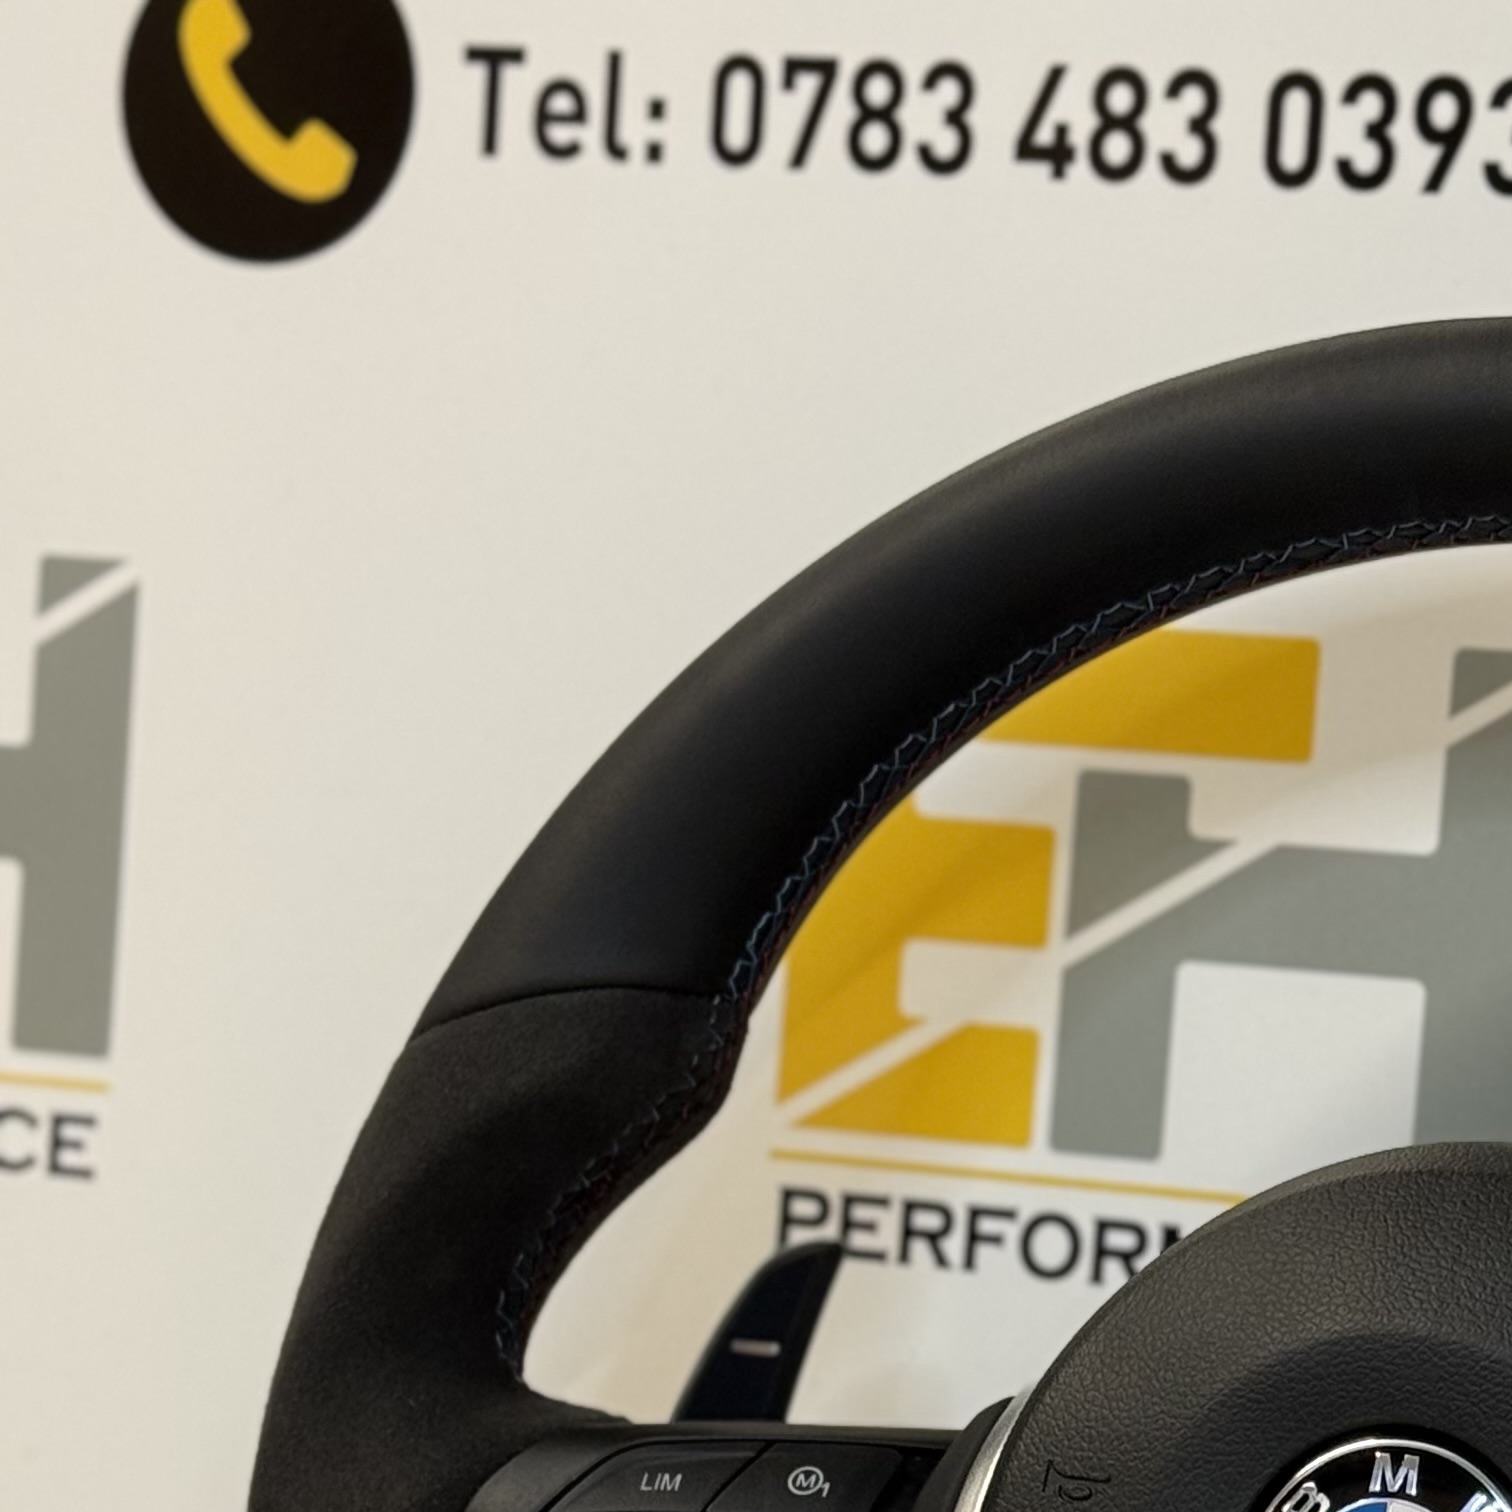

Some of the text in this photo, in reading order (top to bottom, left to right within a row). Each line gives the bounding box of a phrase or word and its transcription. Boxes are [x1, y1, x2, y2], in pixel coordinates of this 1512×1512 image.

[464, 45, 665, 163] Tel:
[710, 54, 976, 175] 0783
[1014, 64, 1221, 186] 483
[777, 1186, 1182, 1286] PERFOR
[640, 1472, 682, 1492] LIM
